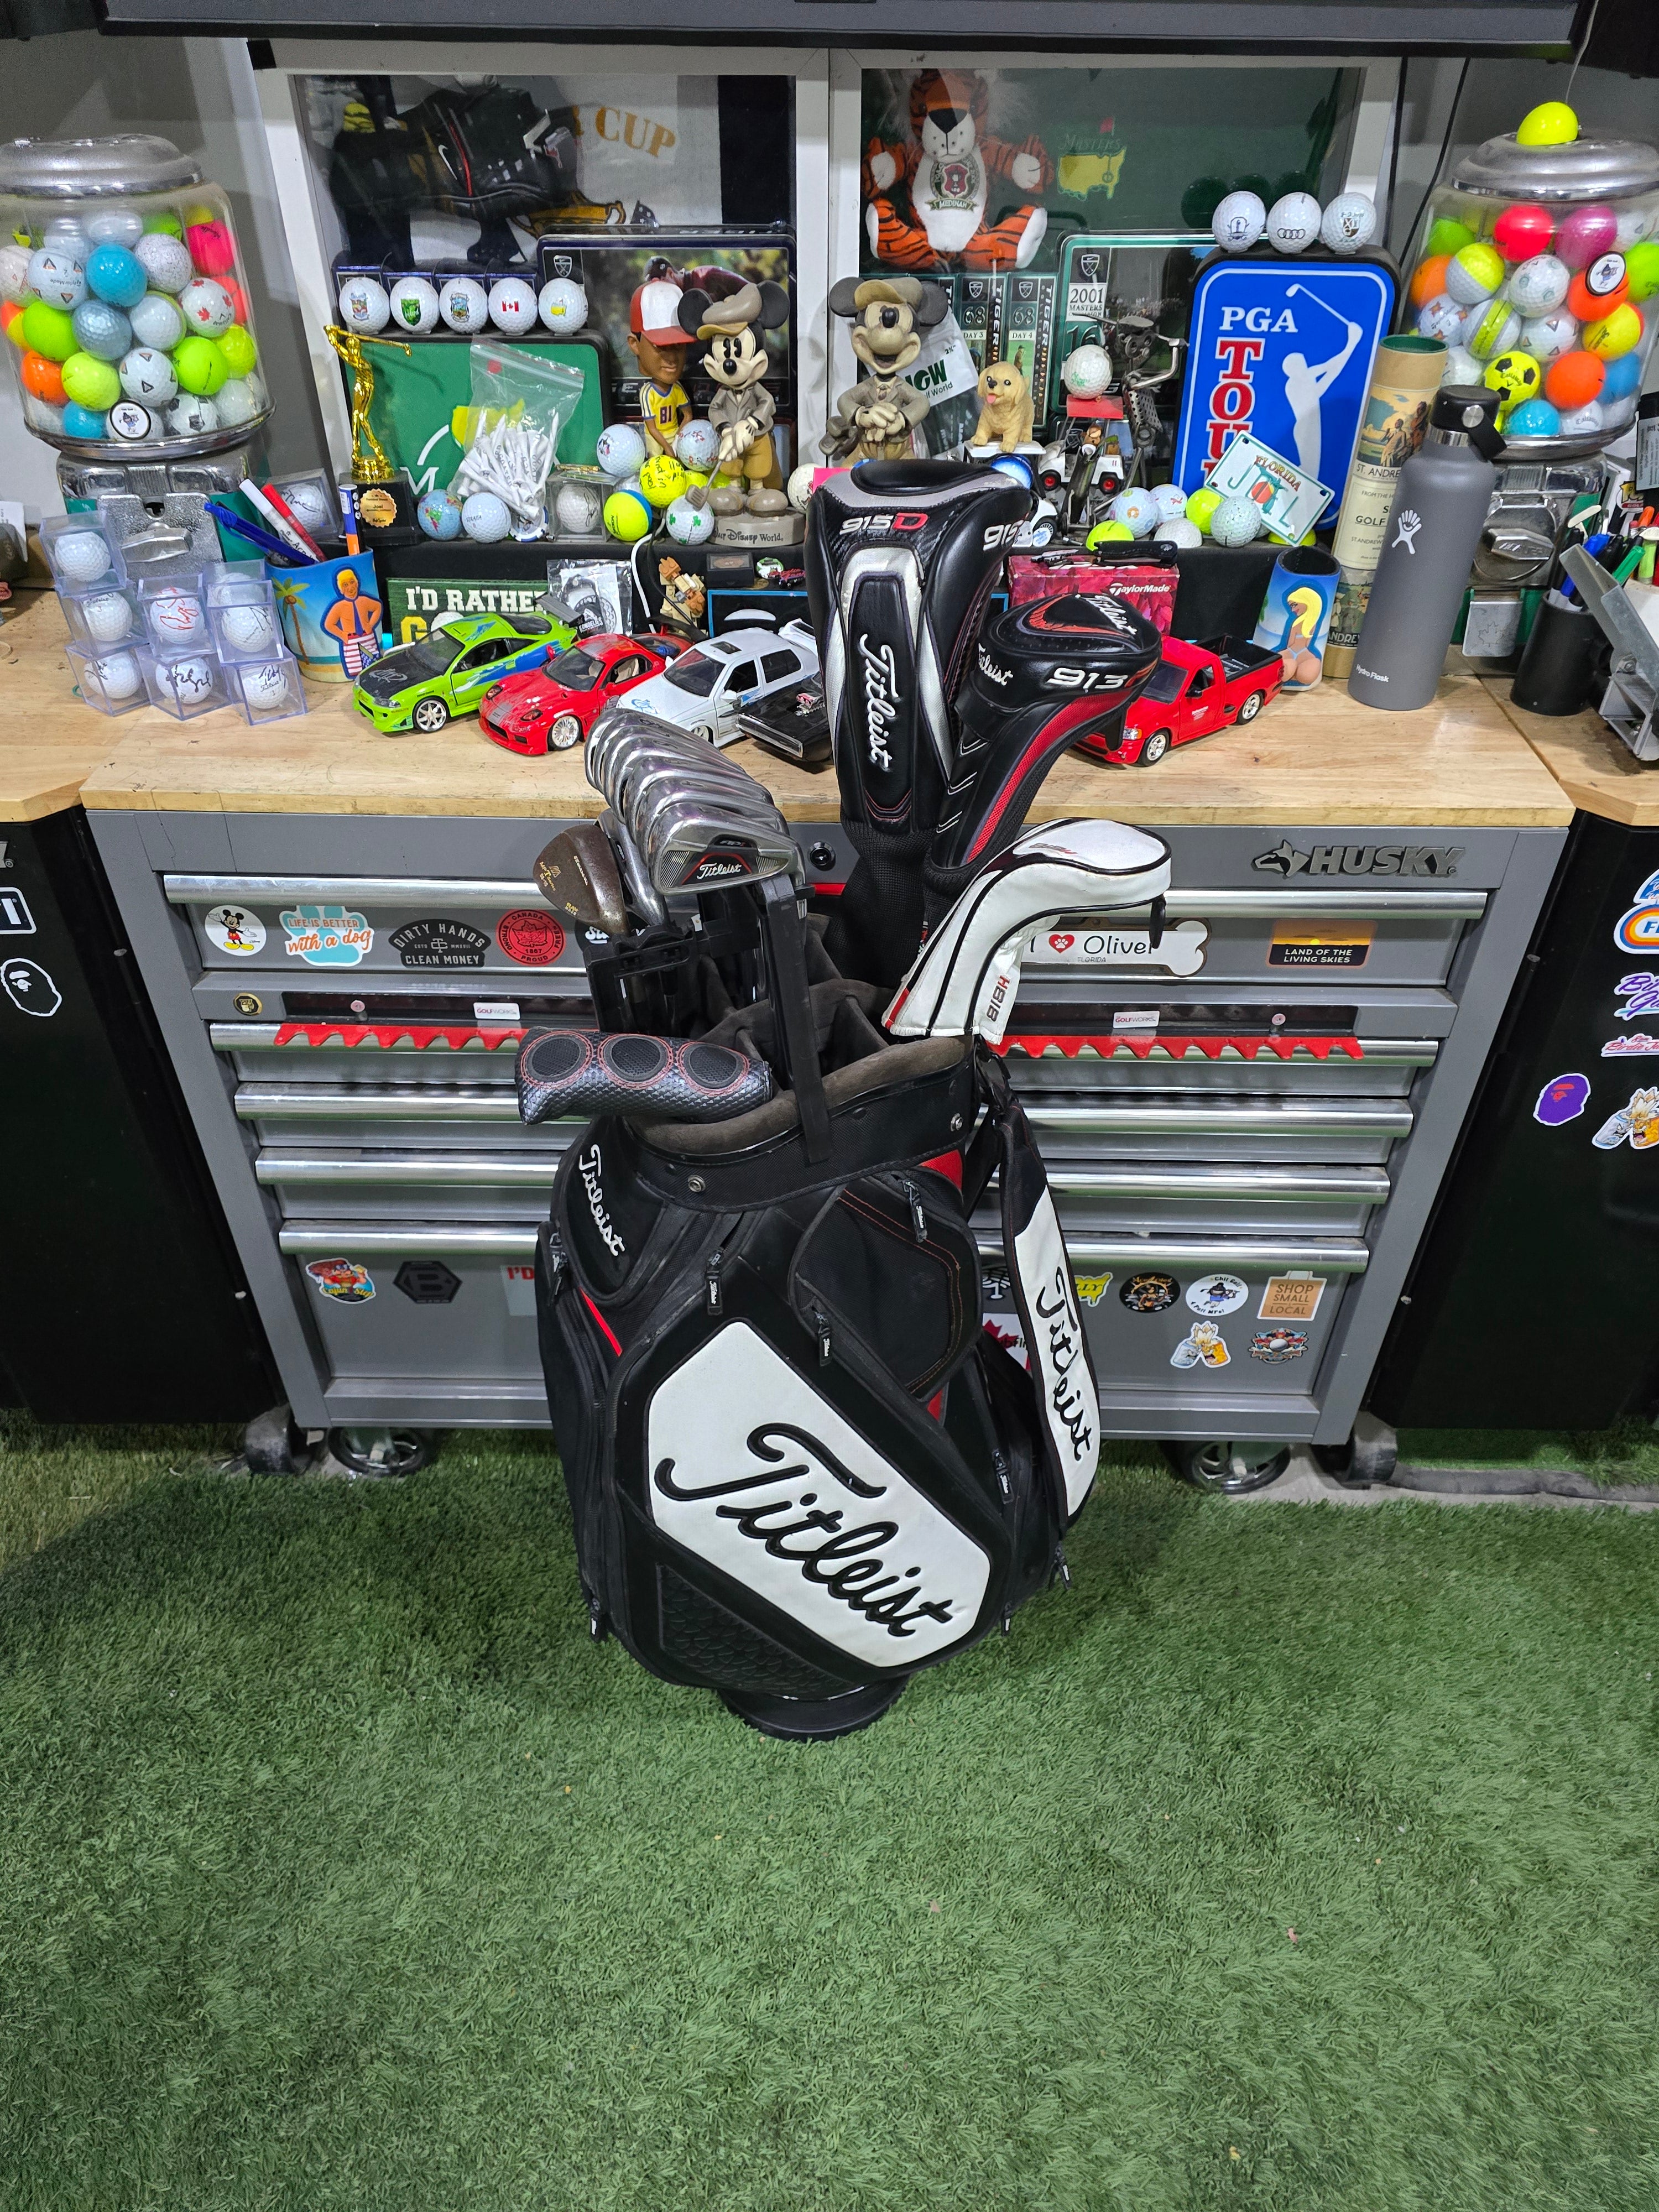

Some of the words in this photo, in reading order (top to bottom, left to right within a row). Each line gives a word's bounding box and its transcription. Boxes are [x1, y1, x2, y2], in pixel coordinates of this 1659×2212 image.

[594, 106, 676, 158] CUP
[938, 200, 968, 209] MEDINAH
[1070, 288, 1103, 304] 2001
[963, 306, 985, 326] 68
[993, 284, 1003, 346] TIGER
[1013, 306, 1035, 326] 68
[1042, 285, 1052, 346] TIGER
[1218, 306, 1298, 332] PGA
[932, 381, 953, 397] World
[1254, 455, 1301, 492] FLORIDA
[1369, 468, 1401, 479] ANDRE
[466, 515, 482, 523] STRATA
[840, 512, 930, 534] 915D
[1355, 515, 1386, 526] GOLF
[406, 586, 440, 610] I'D
[1109, 583, 1172, 596] TaylorMade
[1048, 667, 1128, 690] 913
[1356, 664, 1371, 678] Hydro
[1371, 671, 1390, 683] Flask
[860, 633, 900, 771] Titleist
[1308, 846, 1465, 875] HUSKY
[696, 862, 742, 879] Titleist
[289, 919, 308, 927] LIFE
[311, 919, 320, 927] IS
[323, 919, 359, 928] BETTER
[512, 914, 544, 922] CANADA
[288, 935, 322, 953] with
[326, 936, 338, 947] a
[342, 928, 374, 951] dog
[395, 923, 430, 948] DIRTY
[438, 923, 484, 947] HANDS
[501, 924, 513, 951] STRONG
[1030, 935, 1037, 953] I
[405, 955, 440, 964] CLEAN
[444, 955, 479, 965] MONEY
[1605, 1042, 1644, 1052] Birdie
[580, 1144, 626, 1257] Titleist
[1272, 1293, 1310, 1303] SMALL
[1276, 1284, 1314, 1294] SHOP
[1194, 1304, 1207, 1313] Pull
[1269, 1306, 1306, 1315] LOCAL
[1036, 1266, 1093, 1462] Titleist
[654, 1423, 954, 1637] Titleist
